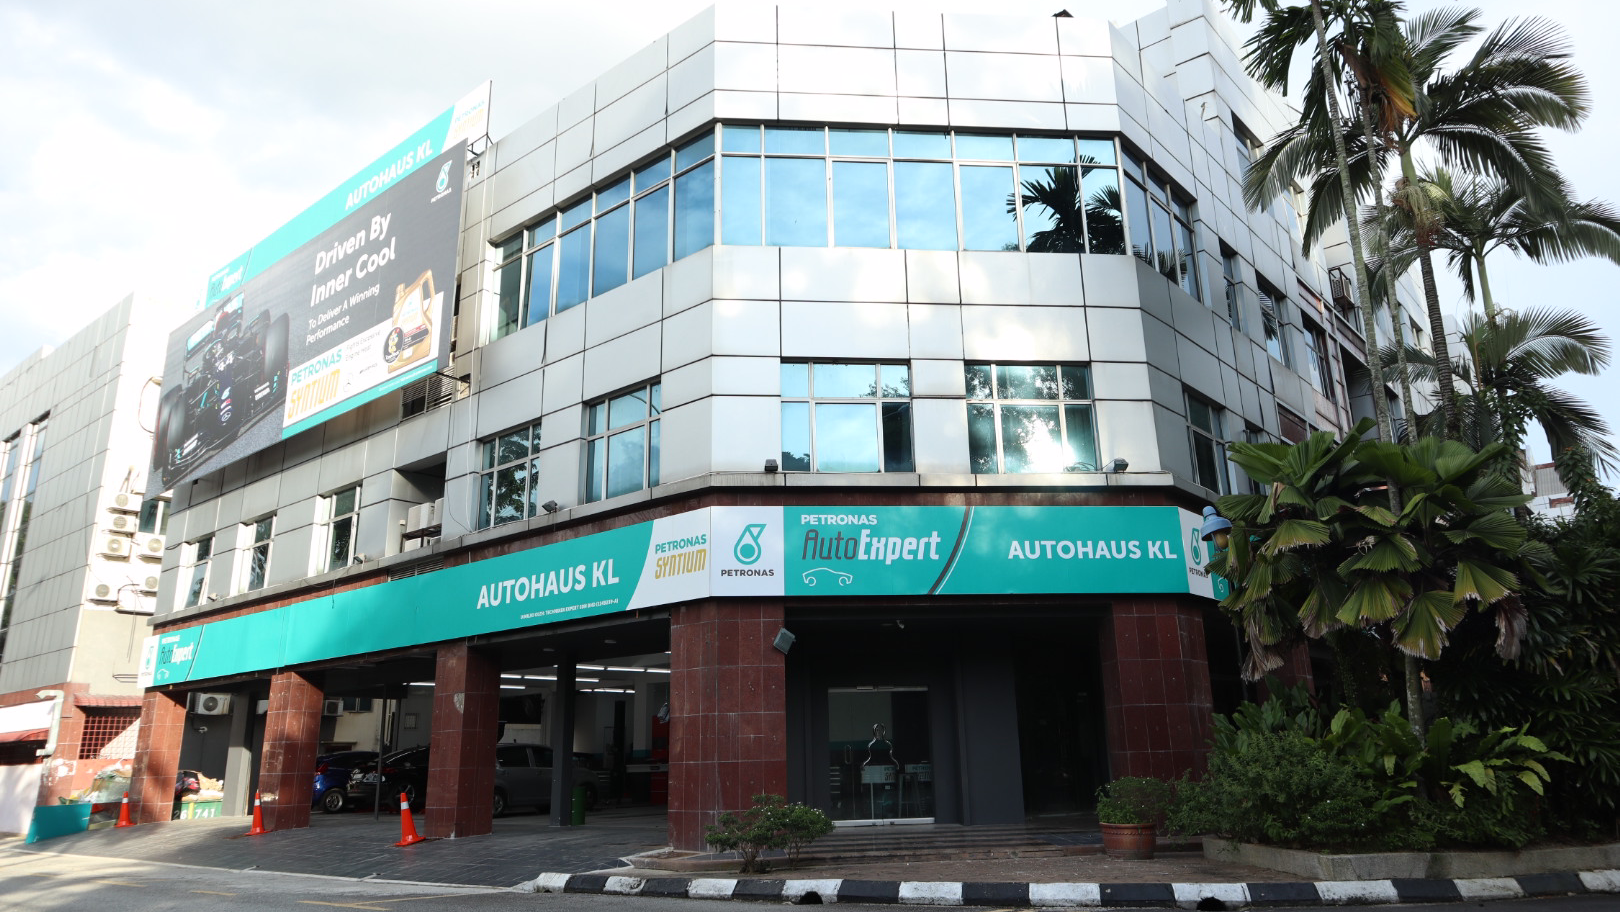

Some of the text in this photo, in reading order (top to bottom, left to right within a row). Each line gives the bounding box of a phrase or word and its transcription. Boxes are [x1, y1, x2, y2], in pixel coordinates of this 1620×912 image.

[344, 139, 433, 211] AUTOHAUS KL
[314, 212, 392, 275] Driven By
[310, 236, 396, 308] Inner Cool
[308, 283, 380, 330] To Deliver A Winning
[305, 315, 350, 346] Performance
[290, 348, 343, 386] PETRONAS
[287, 368, 341, 420] SYNTIUM
[801, 514, 877, 525] PETRONAS
[655, 534, 707, 554] PETRONAS
[1008, 540, 1177, 560] AUTOHAUS KL
[654, 548, 707, 580] SYNTIUM
[721, 569, 775, 577] PETRONAS
[476, 558, 620, 610] AUTOHAUS KL
